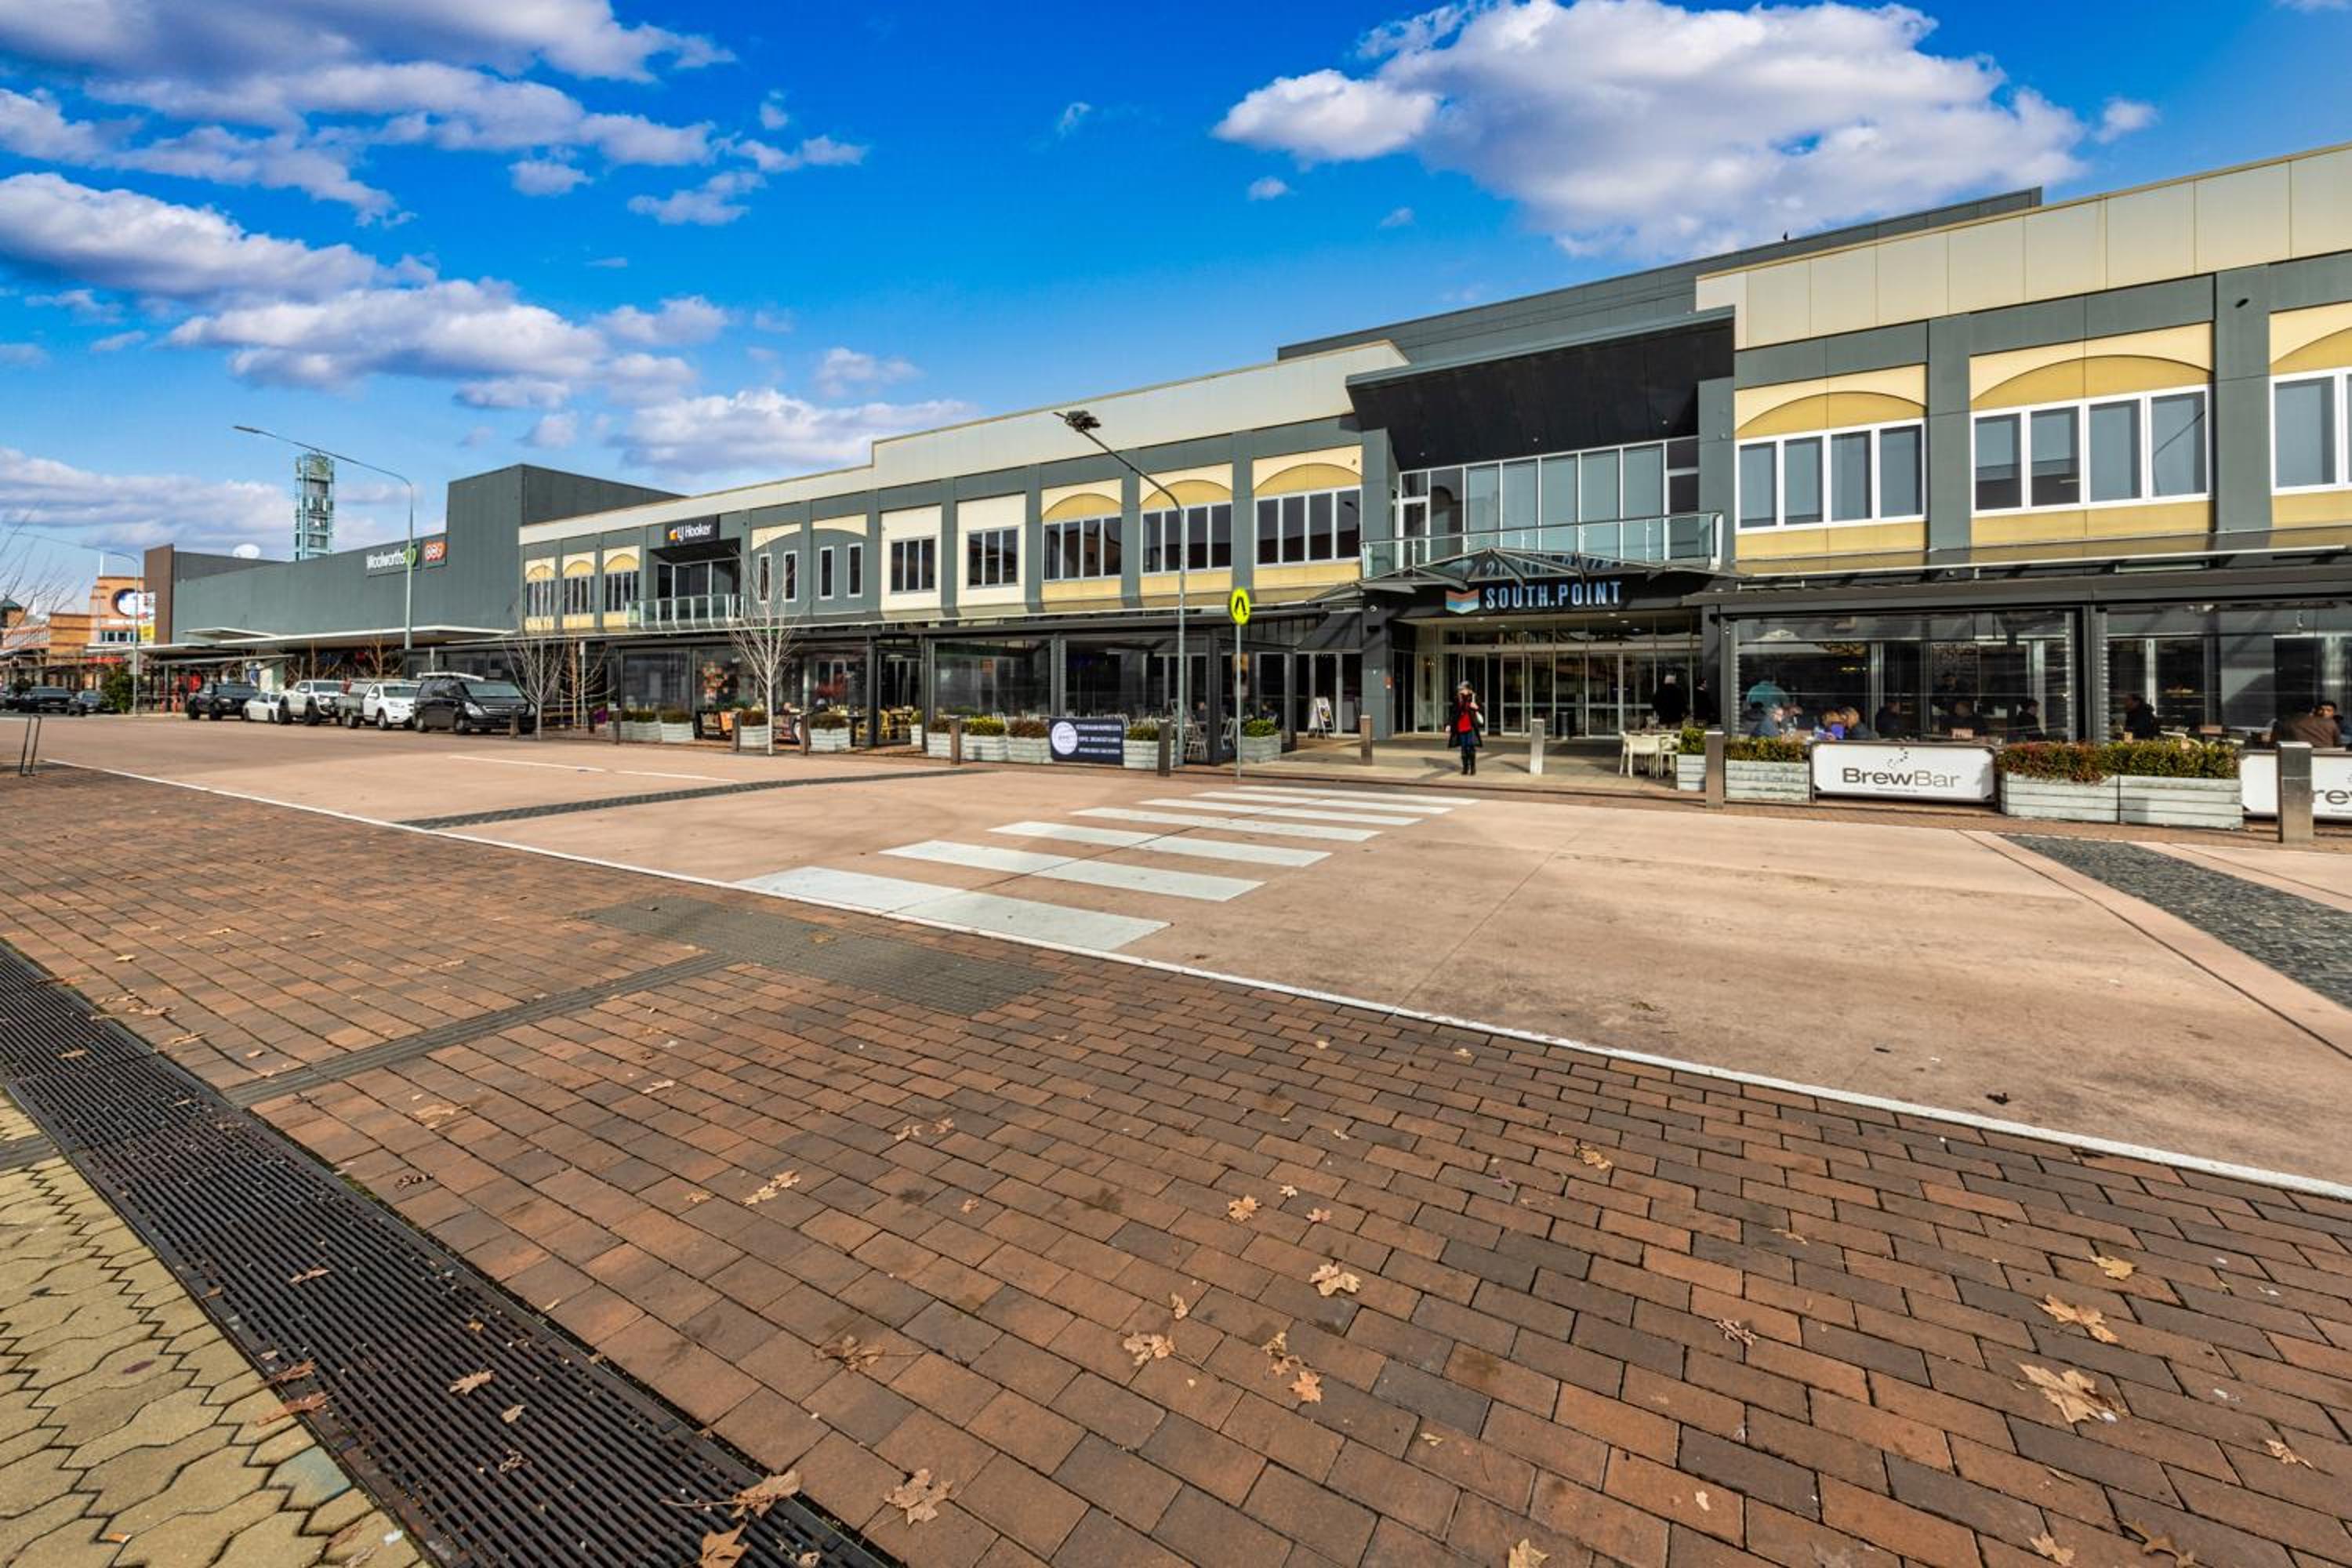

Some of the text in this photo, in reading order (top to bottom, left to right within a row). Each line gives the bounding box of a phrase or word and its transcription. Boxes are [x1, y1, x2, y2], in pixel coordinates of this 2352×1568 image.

[684, 523, 711, 538] Hooker
[366, 548, 405, 569] Woolworths
[1842, 768, 1960, 787] BrewBar
